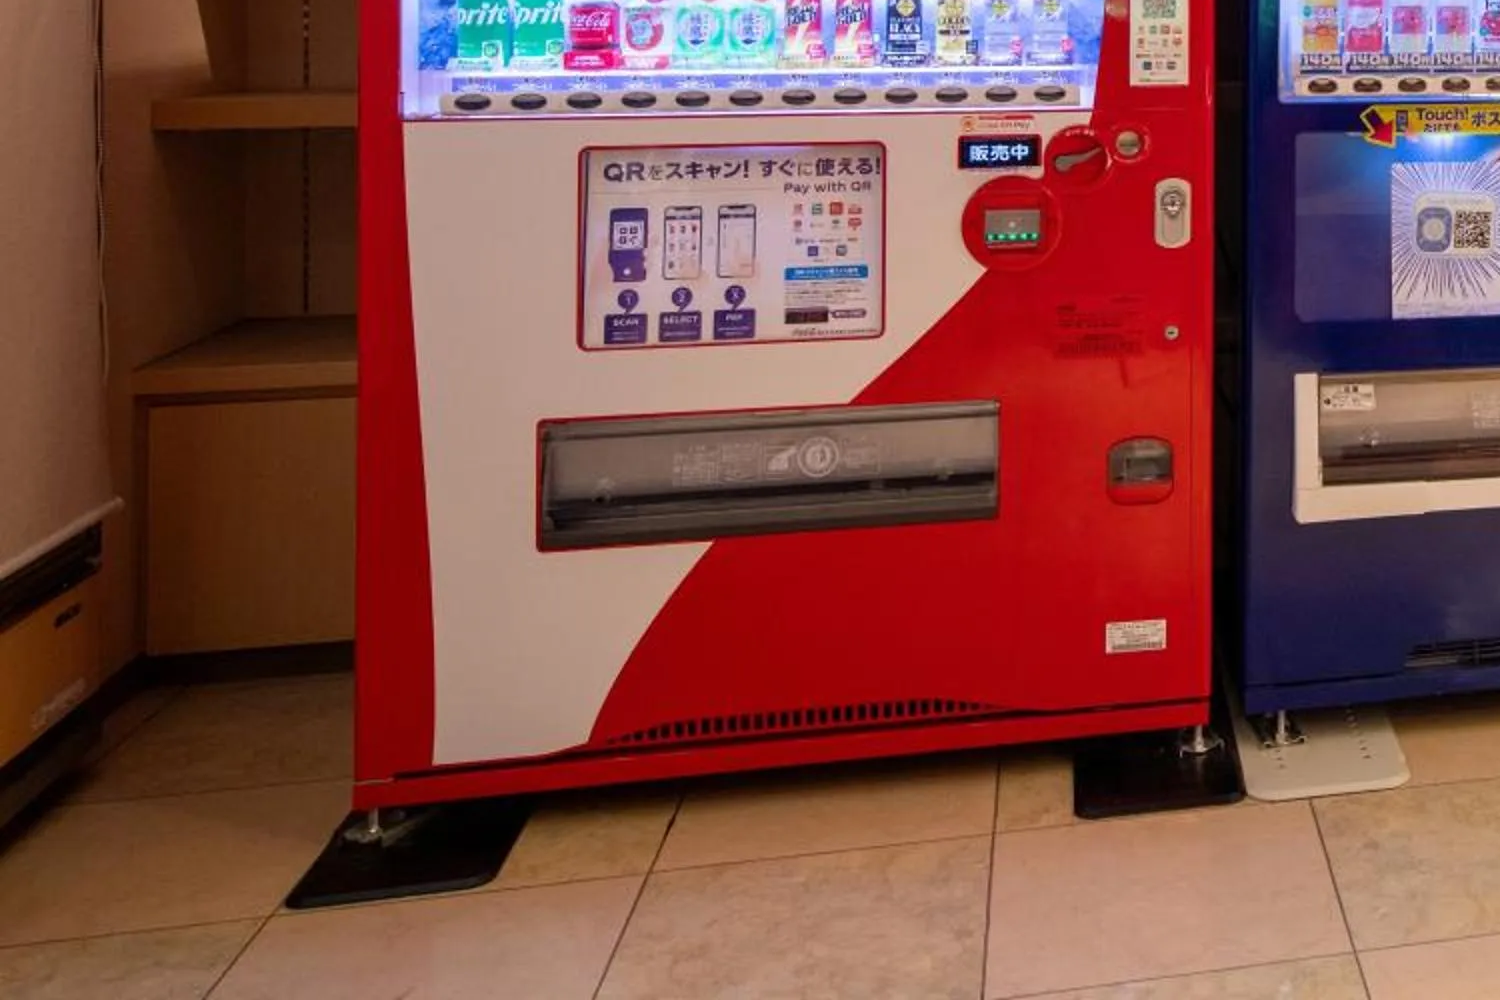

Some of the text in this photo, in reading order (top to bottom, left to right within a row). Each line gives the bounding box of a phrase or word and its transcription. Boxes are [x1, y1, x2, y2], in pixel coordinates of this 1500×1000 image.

[457, 2, 509, 26] prite
[1416, 107, 1469, 122] Touch!
[969, 144, 1029, 162] 販売中
[603, 156, 881, 183] QRをスキャン! すぐに使える!
[783, 180, 872, 195] Pay with QR
[612, 318, 640, 328] SCAN
